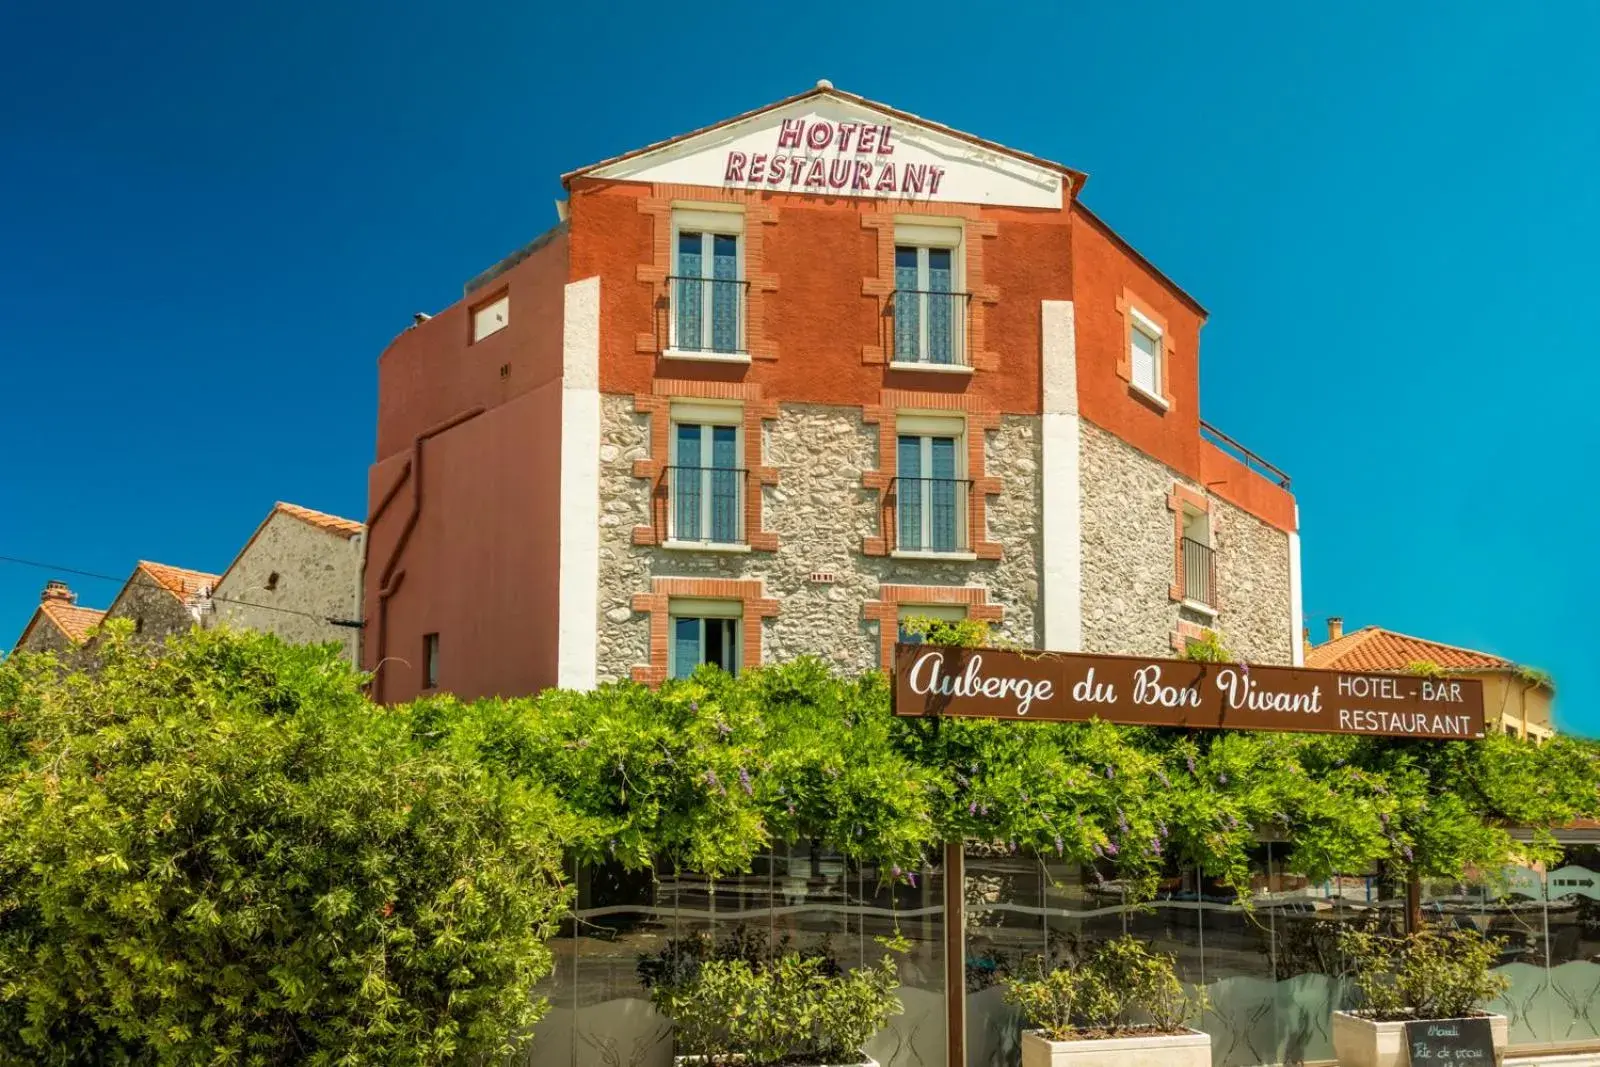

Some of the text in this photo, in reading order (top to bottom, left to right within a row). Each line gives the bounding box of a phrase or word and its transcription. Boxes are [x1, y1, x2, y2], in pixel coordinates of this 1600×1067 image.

[778, 118, 895, 155] HOTEL
[724, 151, 946, 194] RESTAURANT
[909, 651, 1323, 715] Auberge du Bon Vivant
[1337, 676, 1404, 700] HOTEL
[1422, 680, 1464, 703] BAR
[1339, 709, 1471, 735] RESTAURANT
